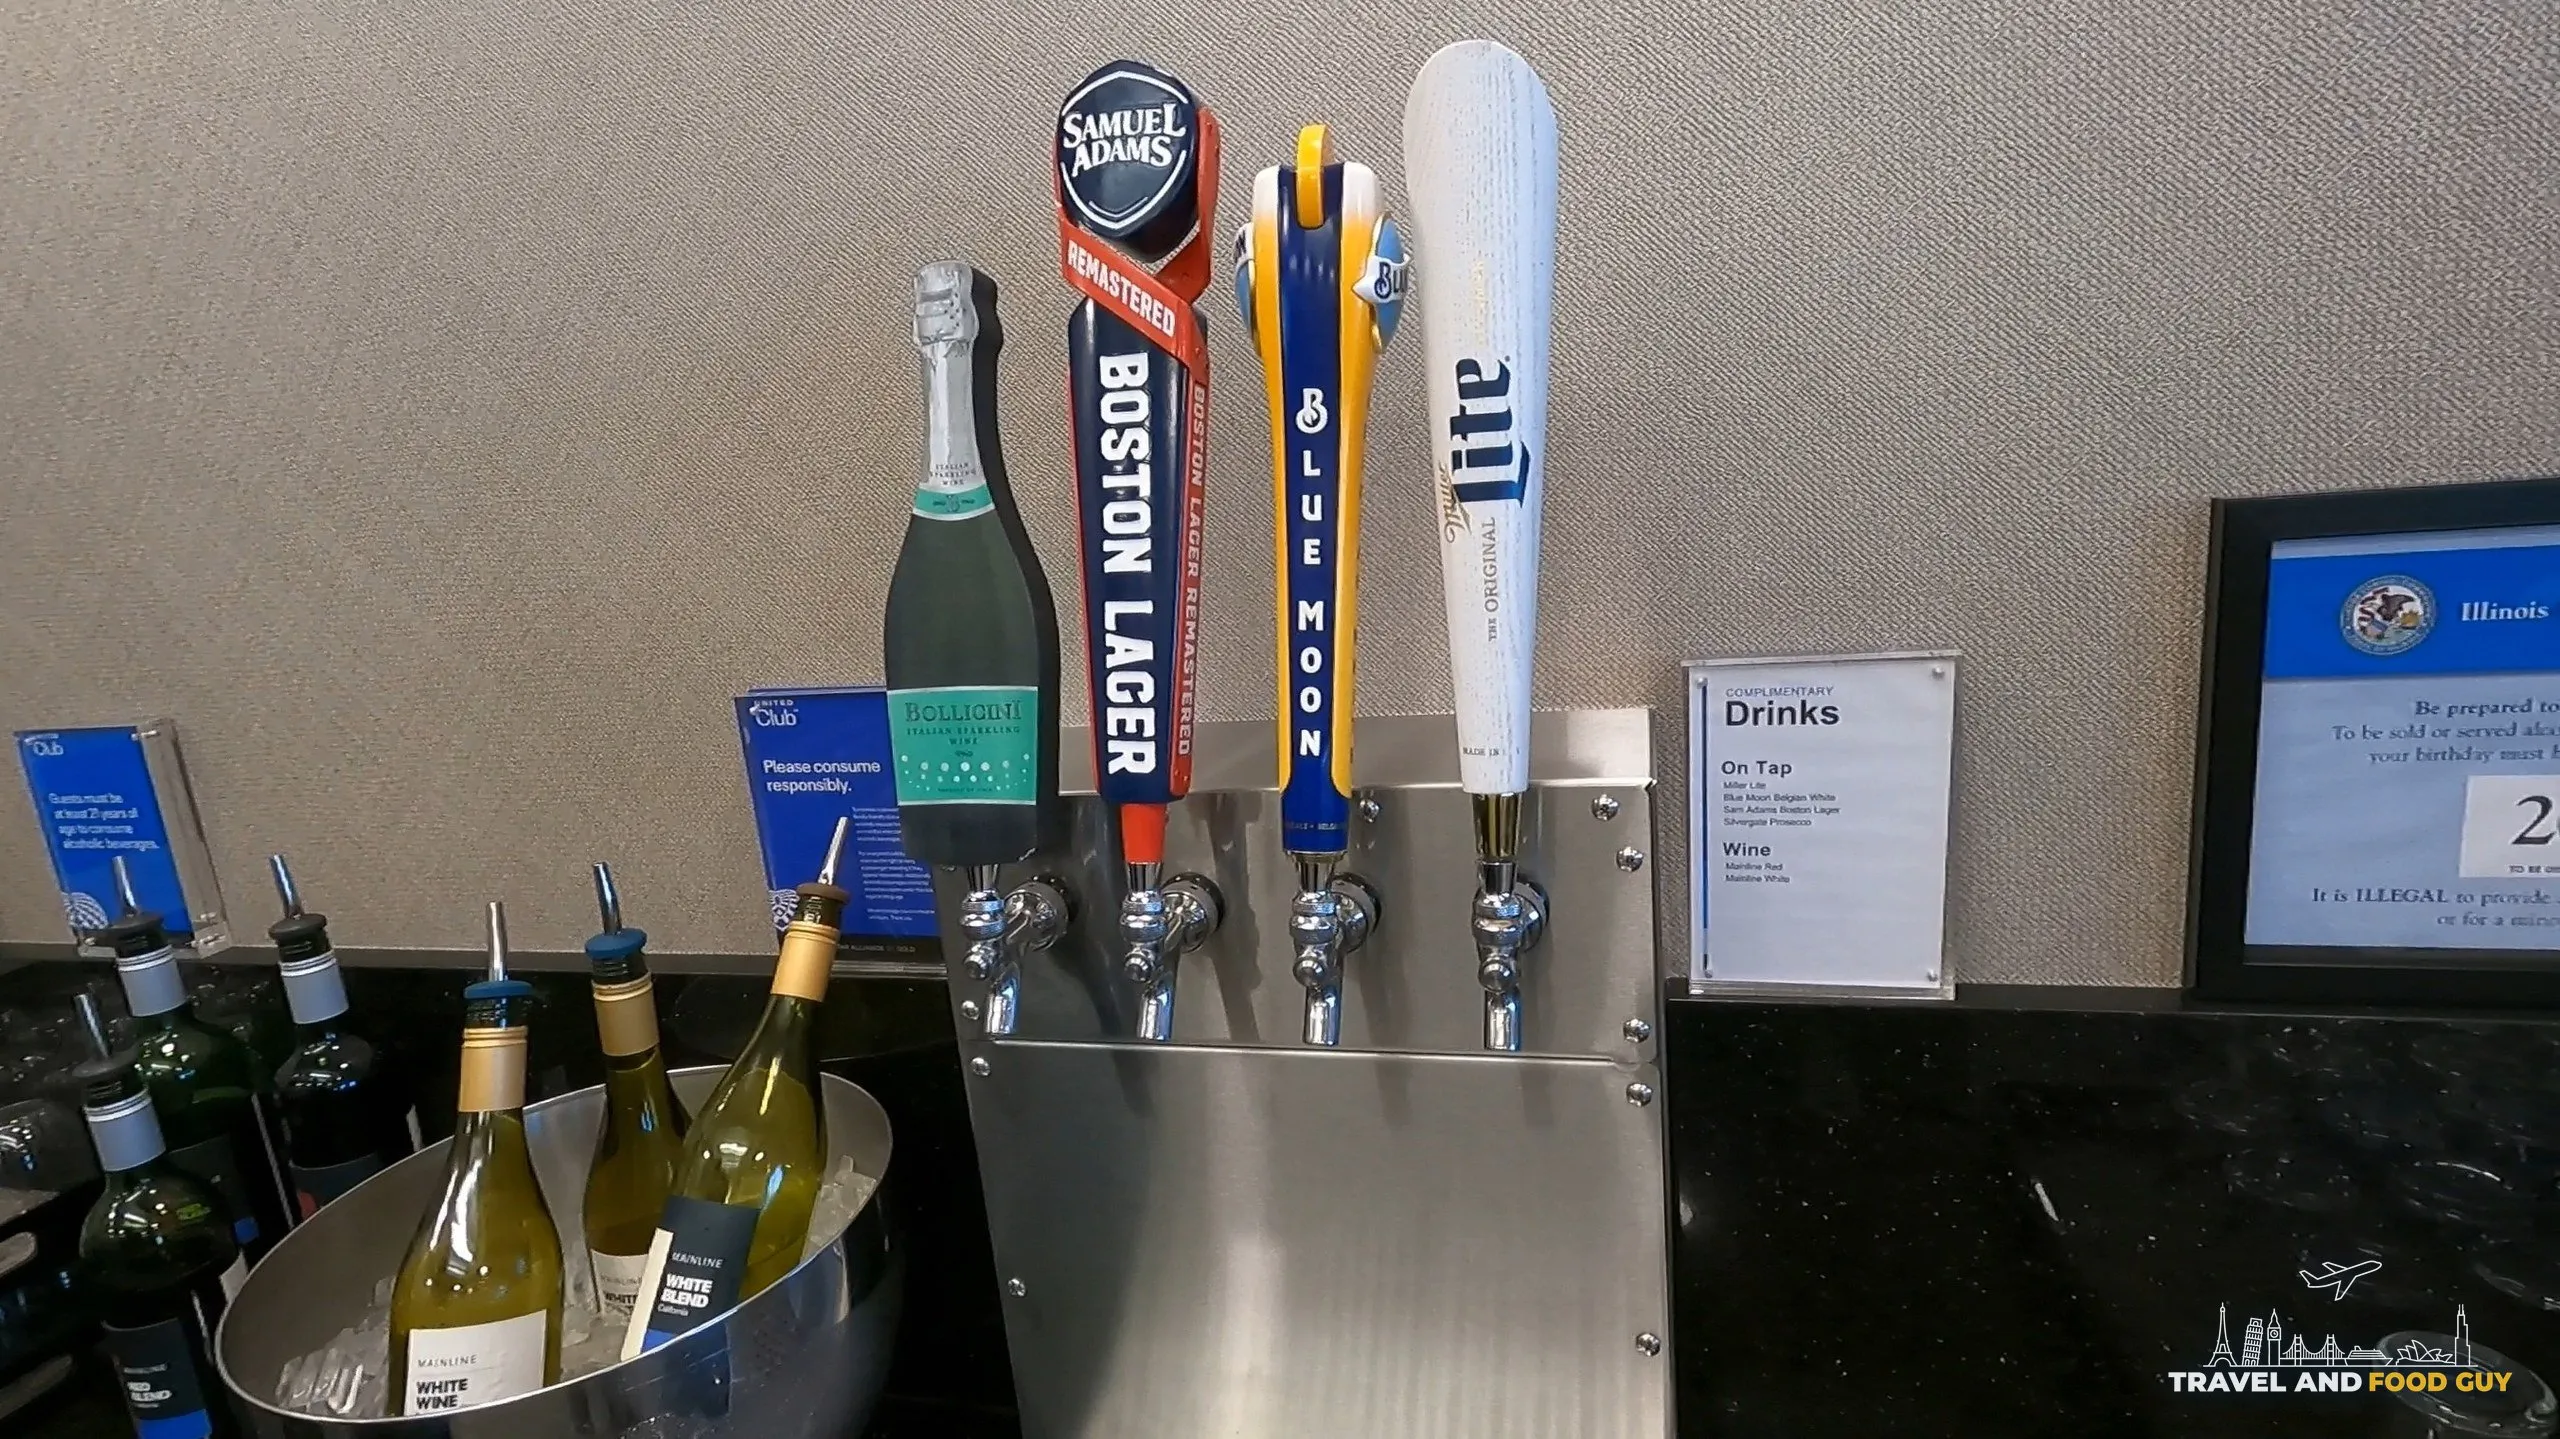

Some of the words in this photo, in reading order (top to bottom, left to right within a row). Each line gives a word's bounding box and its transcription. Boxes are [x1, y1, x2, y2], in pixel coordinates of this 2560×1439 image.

[1063, 102, 1187, 149] SAMUEL
[1071, 136, 1173, 178] ADAMS
[1067, 239, 1176, 339] REMASTERED
[1190, 385, 1206, 487] BOSTON
[1450, 357, 1530, 509] Lite
[1099, 352, 1151, 573] BOSTON
[1295, 387, 1328, 565] BLUE
[1188, 498, 1202, 577] LAGER
[1481, 516, 1499, 613] ORIGINAL
[2461, 602, 2550, 621] Illinois
[1488, 617, 1498, 642] THE
[1177, 586, 1198, 756] REMASTERED
[1297, 600, 1324, 757] MOON
[1103, 600, 1156, 775] LAGER
[1725, 687, 1834, 698] COMPLIMENTARY
[755, 708, 797, 727] Club
[1726, 700, 1840, 726] Drinks
[2415, 701, 2440, 716] Be
[2447, 698, 2532, 718] prepared
[2540, 698, 2560, 713] to
[907, 728, 952, 736] ITALIAN
[957, 726, 1020, 735] SPARKLING
[2332, 725, 2356, 740] To
[2362, 724, 2383, 739] be
[2389, 724, 2427, 739] sold
[2431, 727, 2451, 738] or
[2456, 721, 2518, 737] served
[949, 737, 978, 745] WINE
[2367, 750, 2410, 764] your
[2415, 746, 2494, 764] birthday
[763, 760, 811, 773] Please
[813, 761, 880, 773] consume
[1721, 760, 1749, 775] On
[1756, 760, 1793, 778] Tap
[766, 777, 852, 795] responsibly.
[1723, 781, 1748, 789] Miller
[1723, 793, 1744, 801] Blue
[1745, 793, 1772, 801] Moon
[1773, 793, 1807, 803] Belgian
[1808, 793, 1837, 802] White
[1723, 805, 1744, 814] Sam
[1746, 806, 1778, 814] Adams
[1779, 806, 1812, 814] Boston
[1813, 806, 1841, 815] Lager
[1769, 817, 1813, 826] Prosecco
[2511, 795, 2560, 845] 2
[1723, 842, 1771, 857] Wine
[1764, 862, 1784, 871] Red
[2312, 888, 2328, 902] It
[2333, 888, 2349, 902] is
[2355, 888, 2449, 904] ILLEGAL
[2455, 893, 2475, 904] to
[2480, 888, 2552, 908] provide
[2462, 911, 2488, 926] for
[2494, 914, 2505, 926] a
[672, 1251, 724, 1269] MAINLINE
[665, 1272, 714, 1294] WHITE
[603, 1290, 639, 1305] WHIT
[660, 1287, 710, 1309] BLEND
[417, 1353, 478, 1368] MAINLINE
[416, 1378, 468, 1394] WHITE
[416, 1394, 458, 1409] WINE
